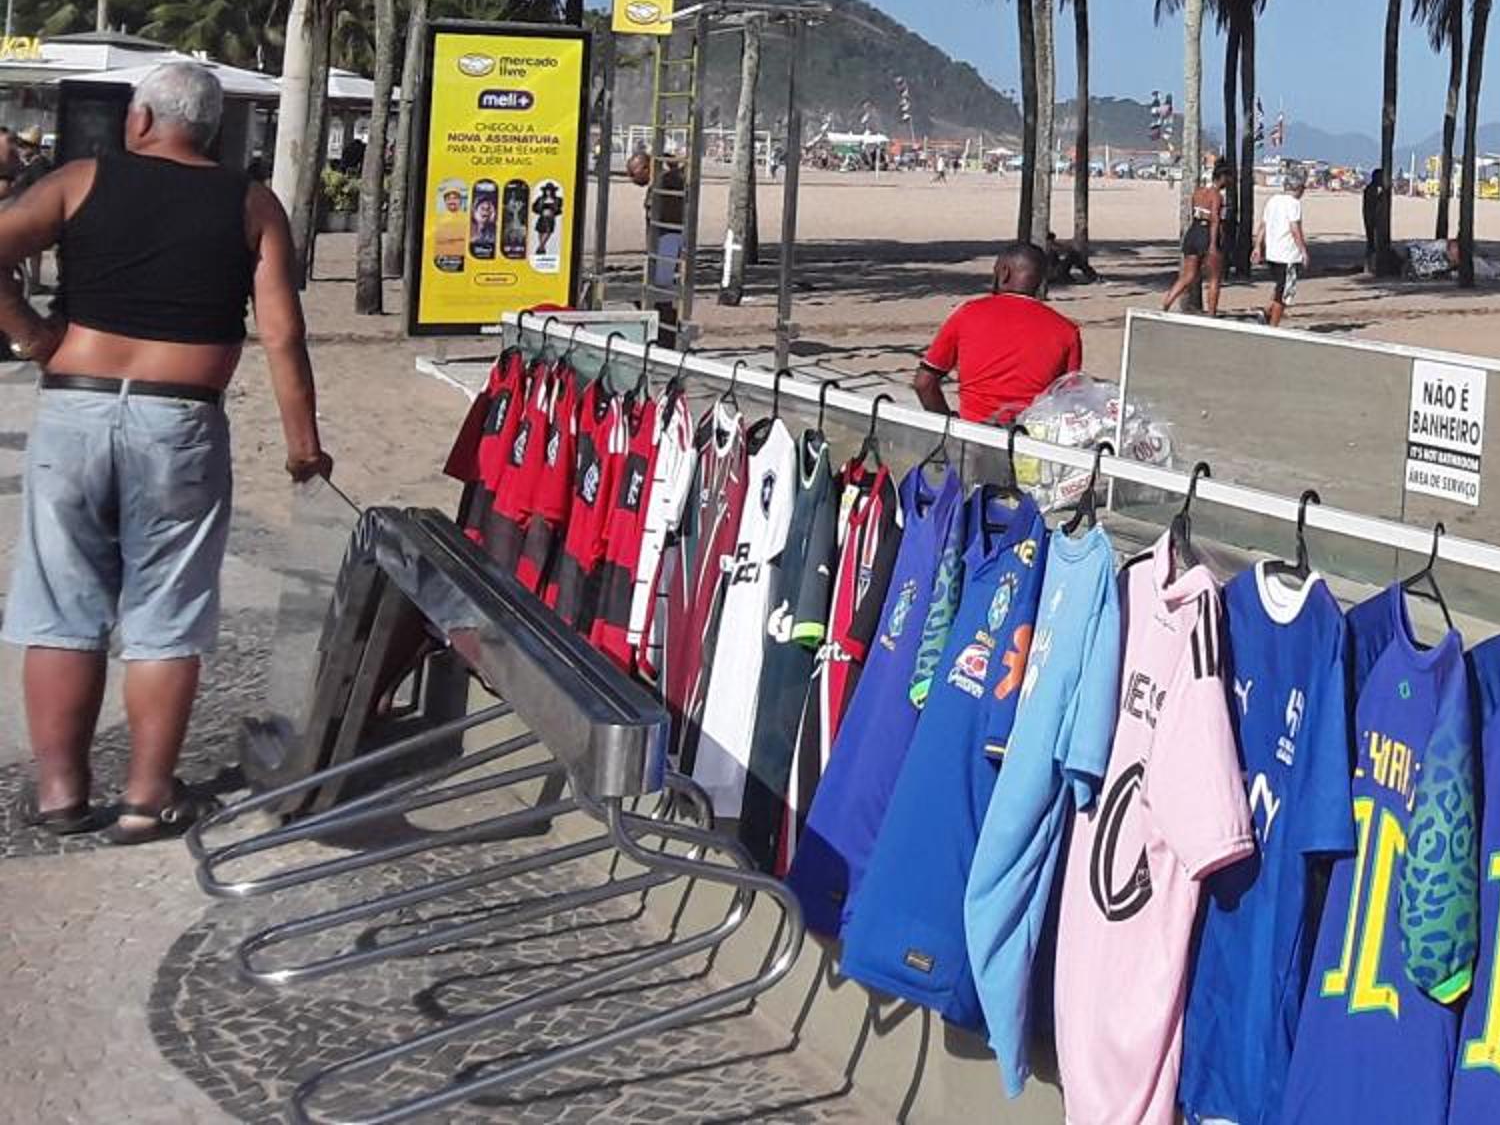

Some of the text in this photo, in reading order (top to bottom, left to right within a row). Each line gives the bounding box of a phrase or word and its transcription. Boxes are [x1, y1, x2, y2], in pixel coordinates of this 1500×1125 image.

[500, 56, 558, 67] mercado
[500, 67, 527, 77] livre
[482, 93, 530, 107] meli+
[475, 122, 523, 132] CHEGOU
[448, 133, 559, 145] NOVA ASSINATURA
[448, 144, 558, 156] PARA QUEM SEMPRE
[471, 156, 502, 166] QUER
[1423, 378, 1469, 412] NÃO É
[1411, 410, 1480, 446] BANHEIRO
[1407, 466, 1477, 500] ÁREA DE SERVIÇO
